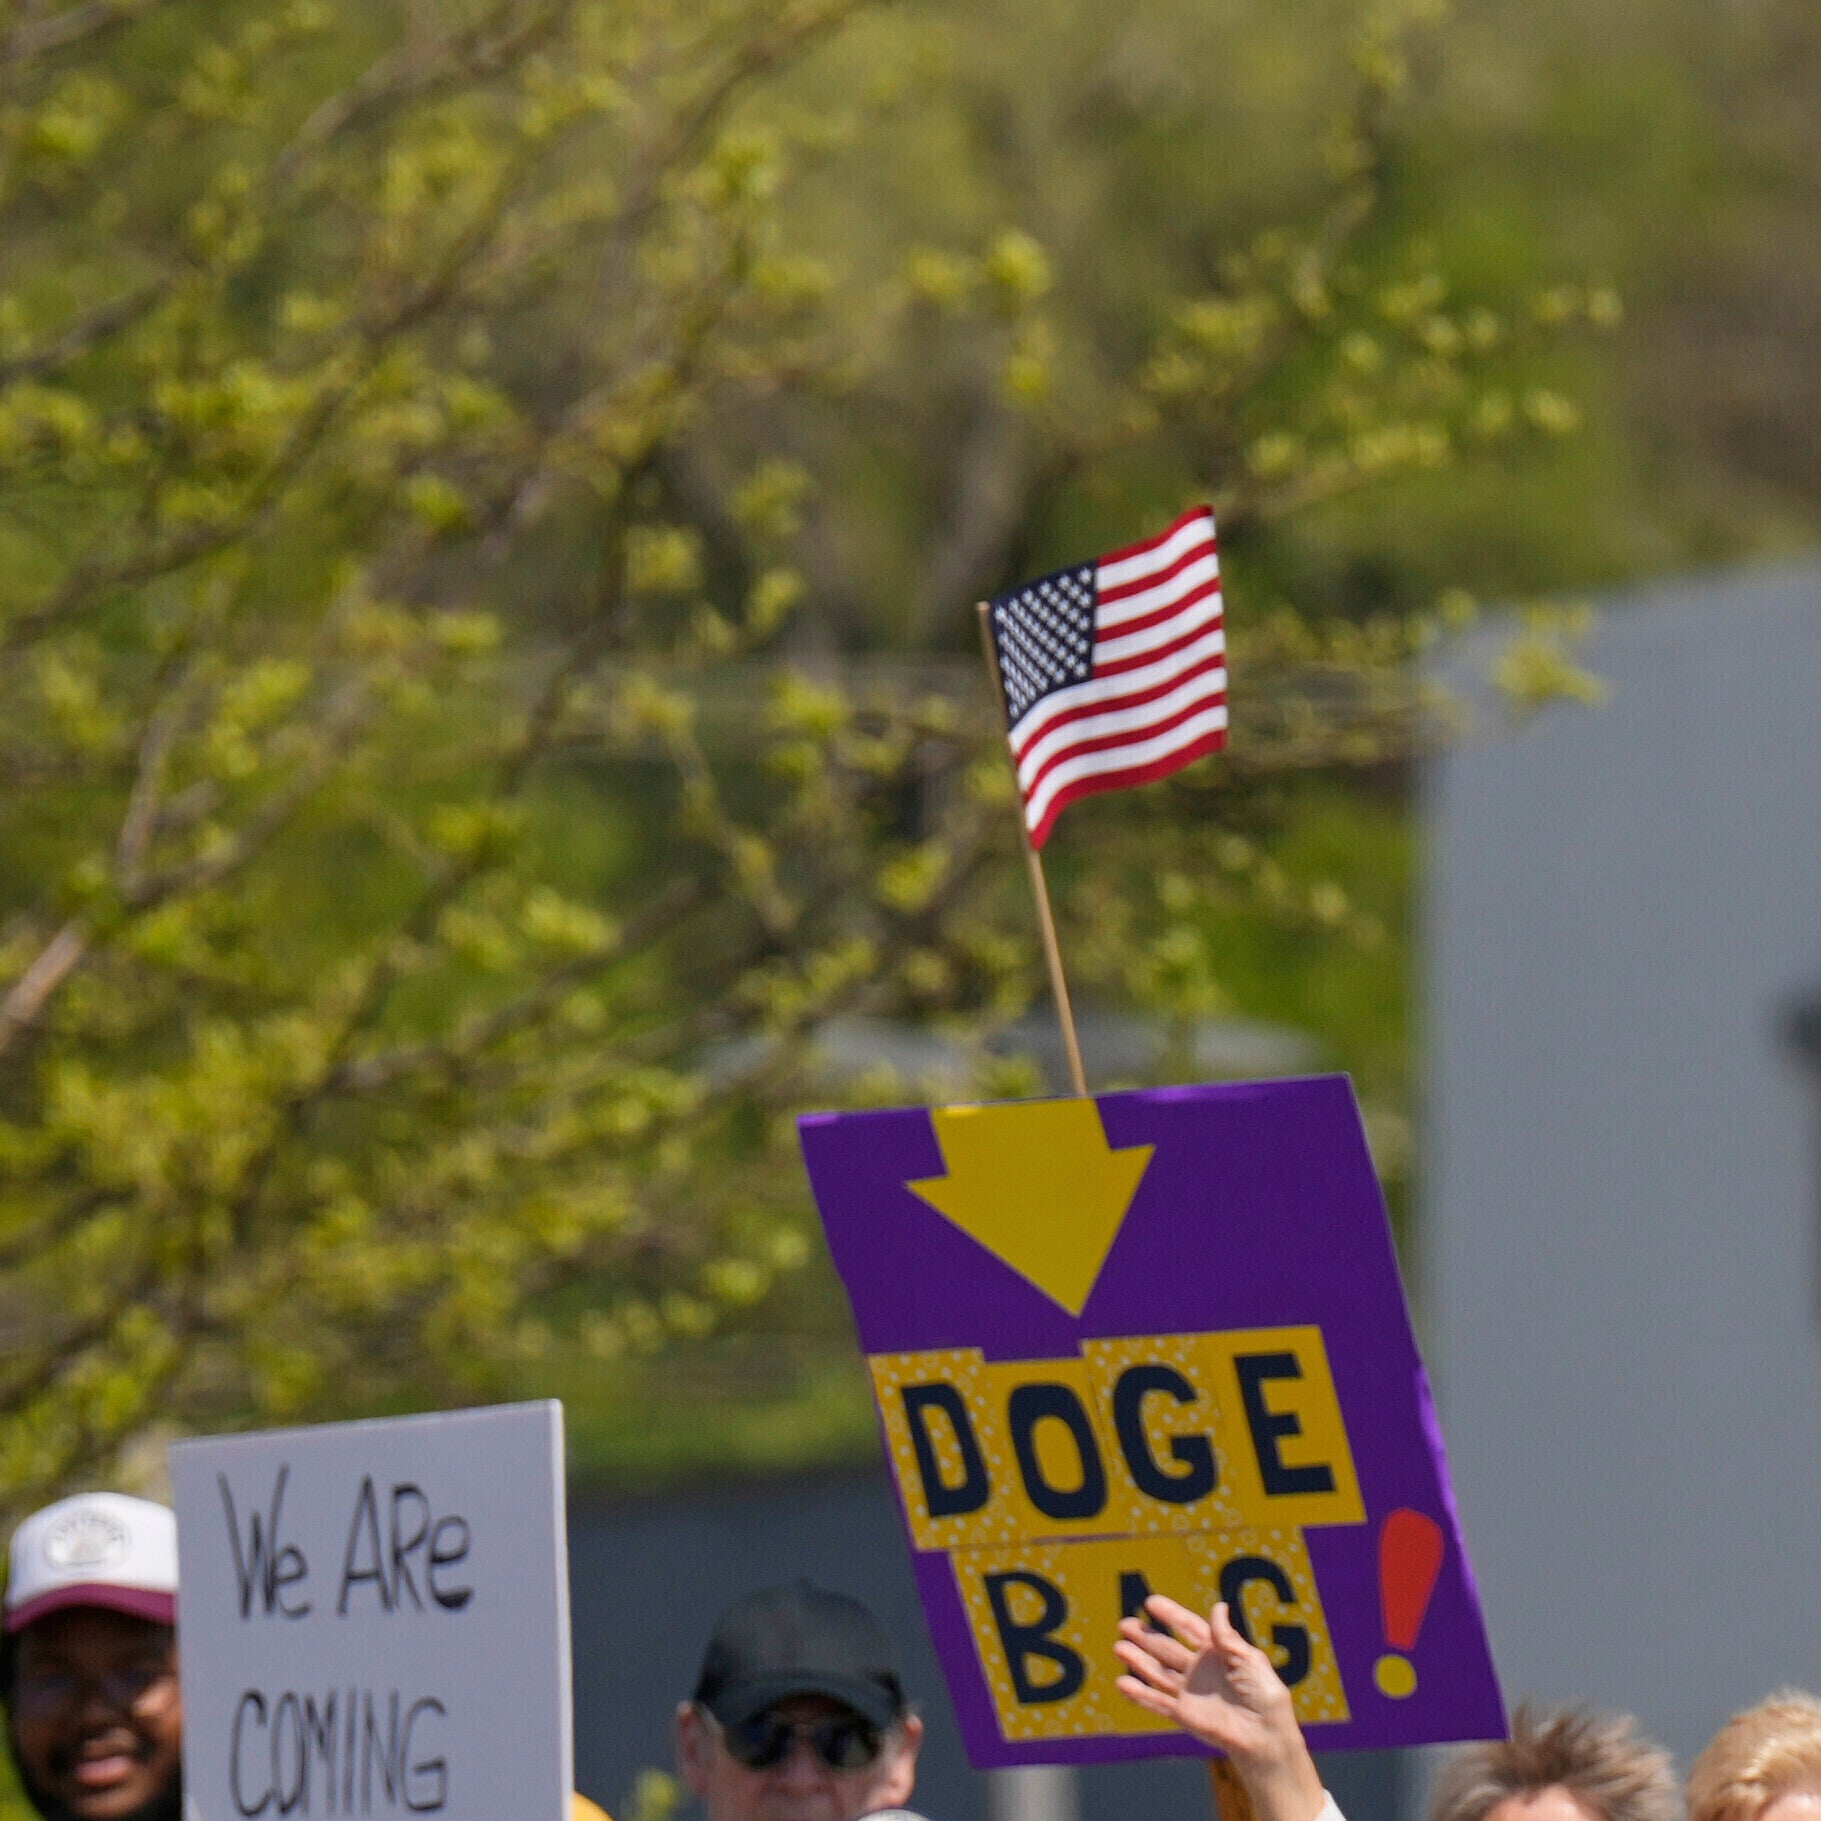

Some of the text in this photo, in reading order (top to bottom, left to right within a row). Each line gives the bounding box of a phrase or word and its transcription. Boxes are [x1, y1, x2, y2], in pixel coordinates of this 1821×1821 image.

[902, 1351, 1339, 1520] DOGE
[216, 1464, 311, 1619] We
[229, 1687, 450, 1819] COMING
